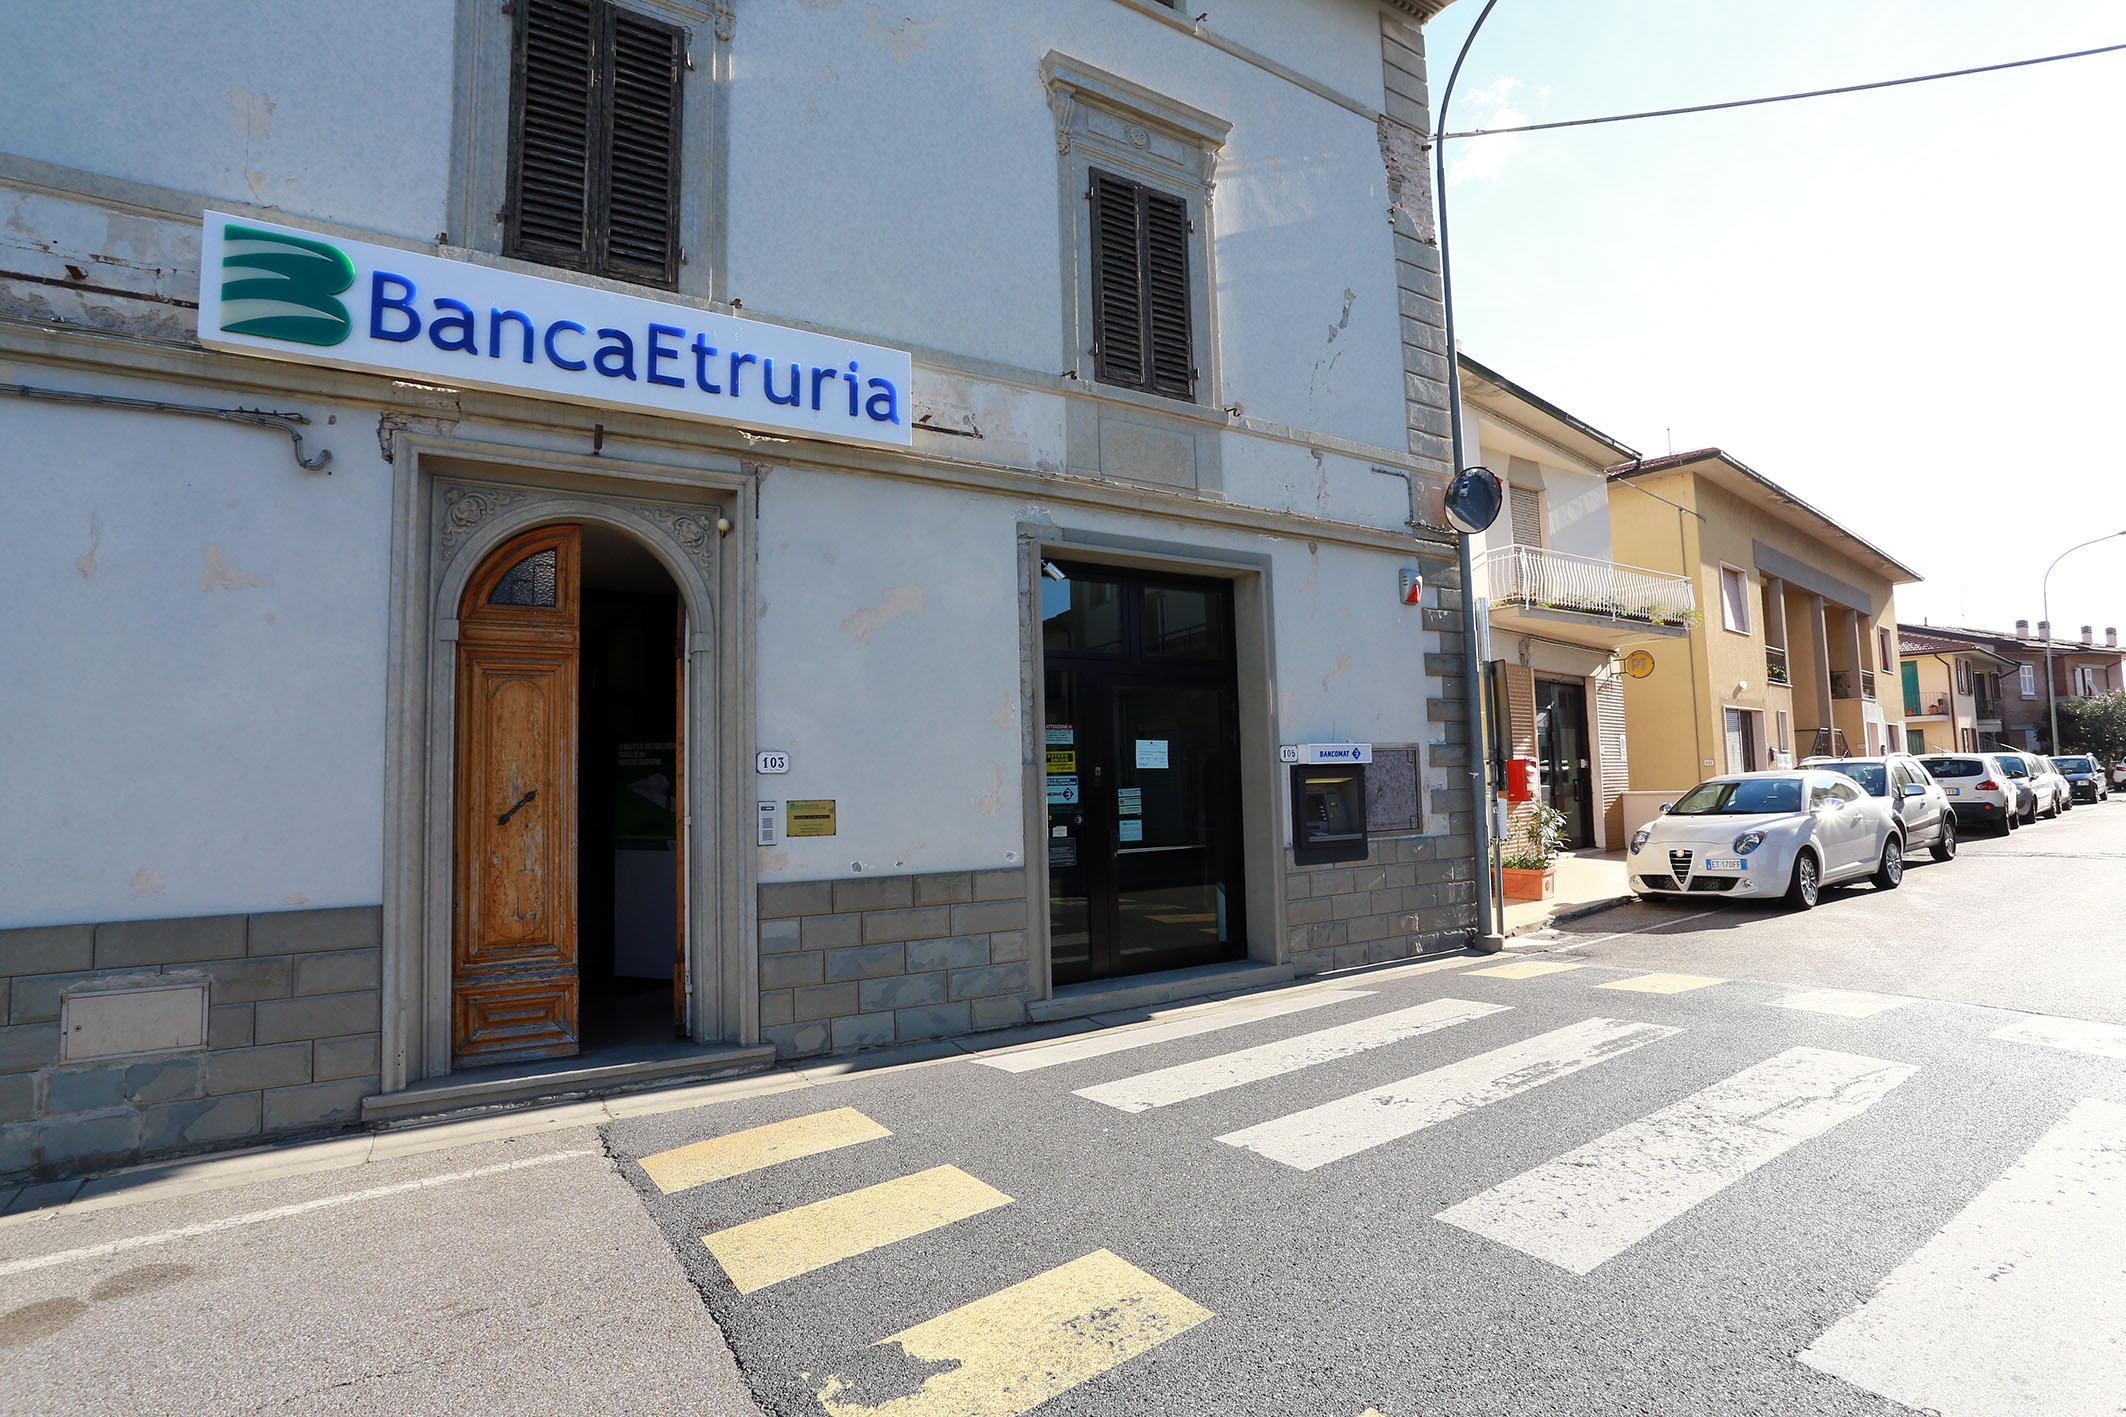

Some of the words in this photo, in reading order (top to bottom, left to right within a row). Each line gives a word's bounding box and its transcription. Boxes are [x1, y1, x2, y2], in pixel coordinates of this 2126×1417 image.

[369, 270, 901, 426] BancaEtruria
[1283, 749, 1296, 758] 105
[1319, 750, 1350, 758] BANCOMAT
[763, 757, 784, 768] 103
